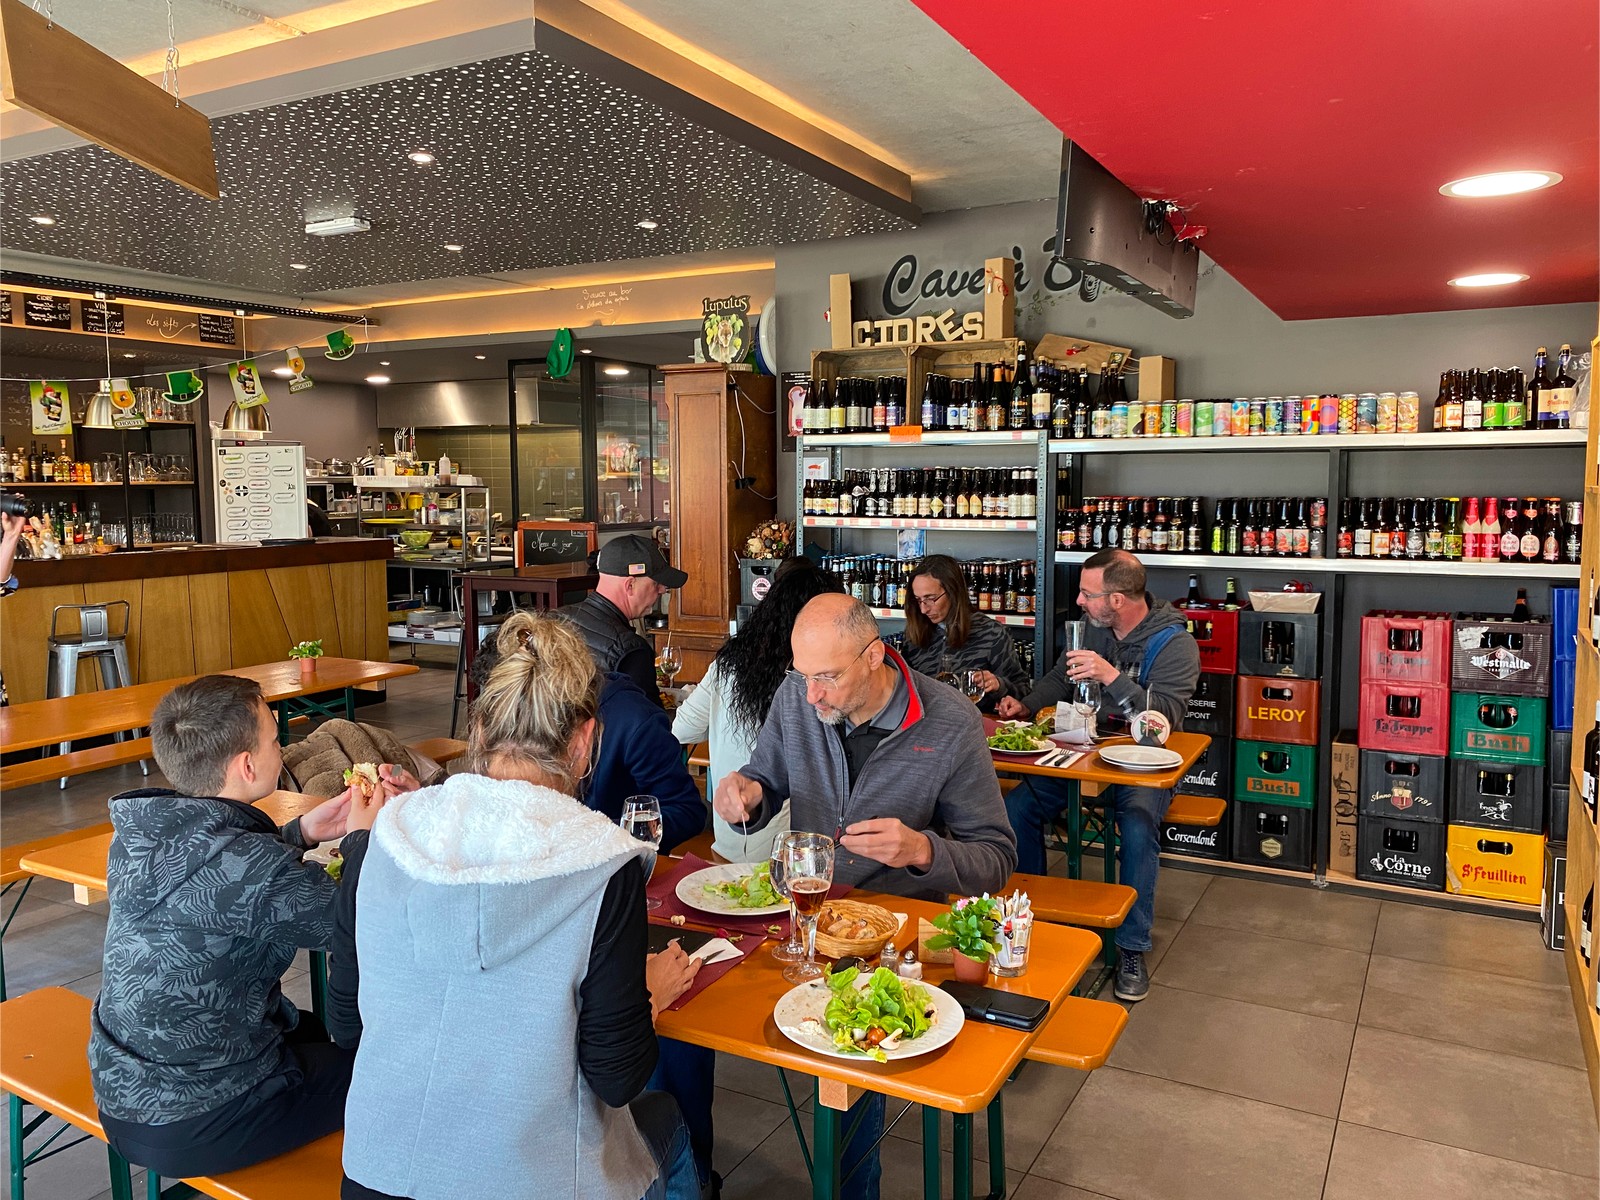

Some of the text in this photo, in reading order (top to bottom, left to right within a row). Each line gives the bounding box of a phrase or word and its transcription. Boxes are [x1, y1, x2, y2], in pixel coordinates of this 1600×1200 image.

[852, 308, 984, 347] CIDRES
[1469, 655, 1533, 670] Westmalle
[1188, 699, 1217, 709] SSERIE
[1184, 711, 1211, 720] UPONT
[1247, 706, 1306, 723] LEROY
[1473, 733, 1524, 750] Bush
[1182, 769, 1219, 787] sendonk
[1251, 779, 1296, 795] Bush
[1165, 826, 1219, 847] Corsendonk
[1383, 857, 1431, 875] Corne
[1473, 865, 1527, 885] Feuillien
